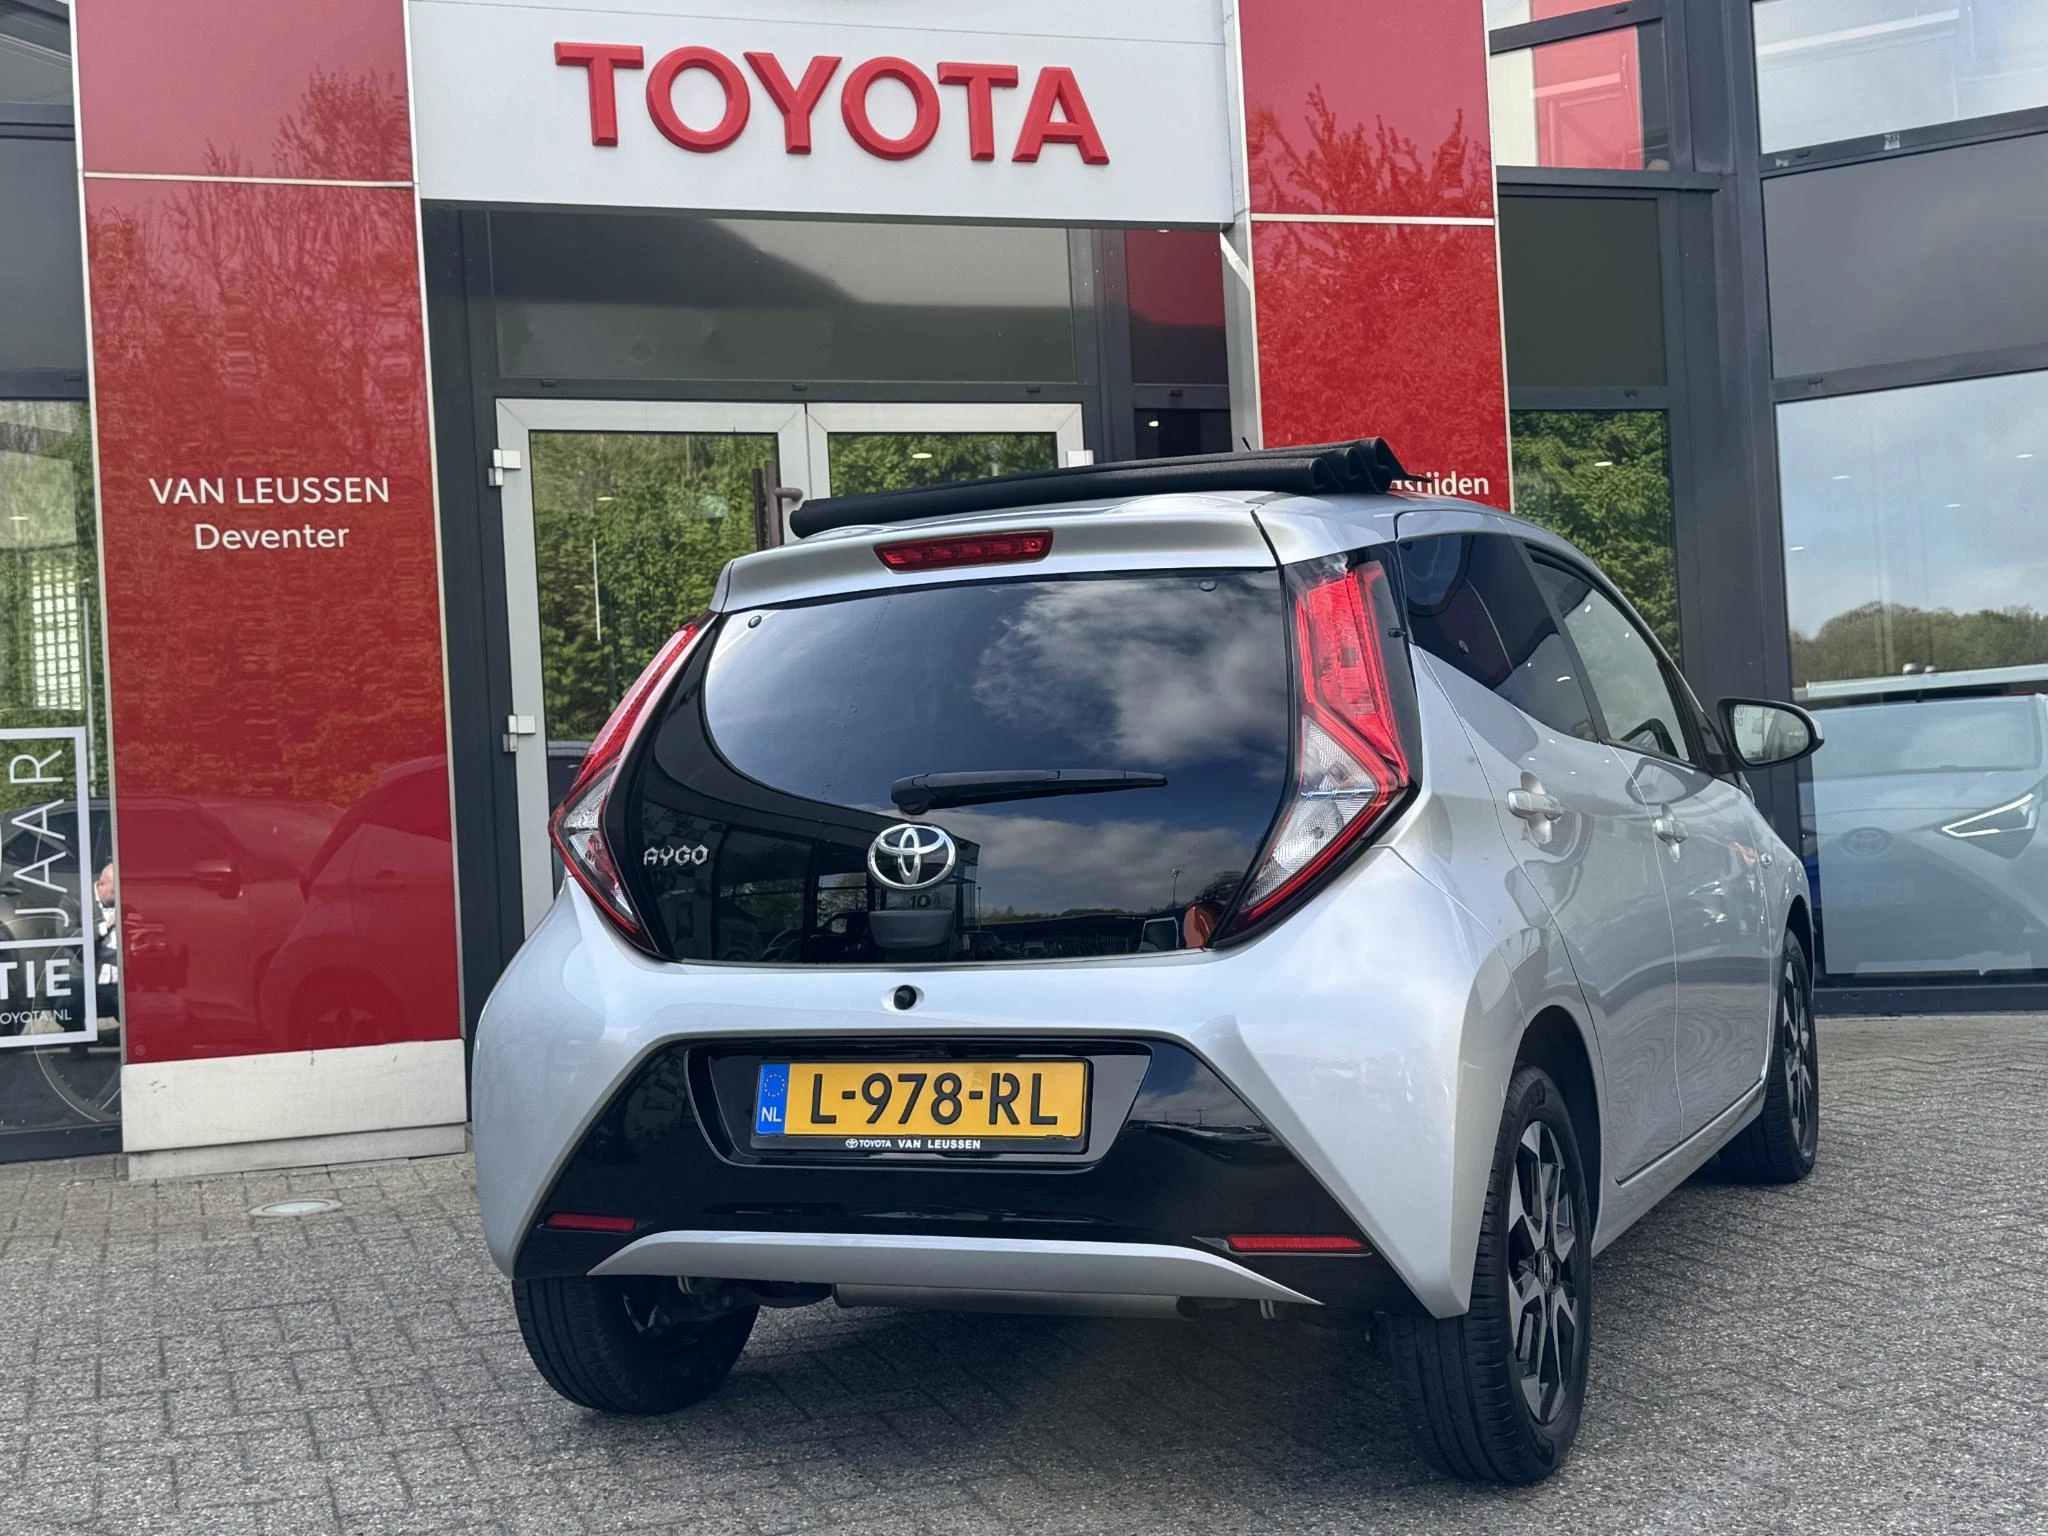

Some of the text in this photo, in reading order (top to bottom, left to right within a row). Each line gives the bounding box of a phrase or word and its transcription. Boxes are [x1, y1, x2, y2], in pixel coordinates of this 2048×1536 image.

[554, 41, 1110, 165] TOYOTA
[149, 477, 390, 504] VAN LEUSSEN
[194, 523, 350, 550] Deventer
[9, 749, 69, 927] JAAR
[643, 844, 709, 866] AYGO
[810, 1072, 1058, 1126] L-978-RL
[761, 1106, 782, 1123] NL
[859, 1139, 981, 1149] TOYOTA VAN LEUSSEN
